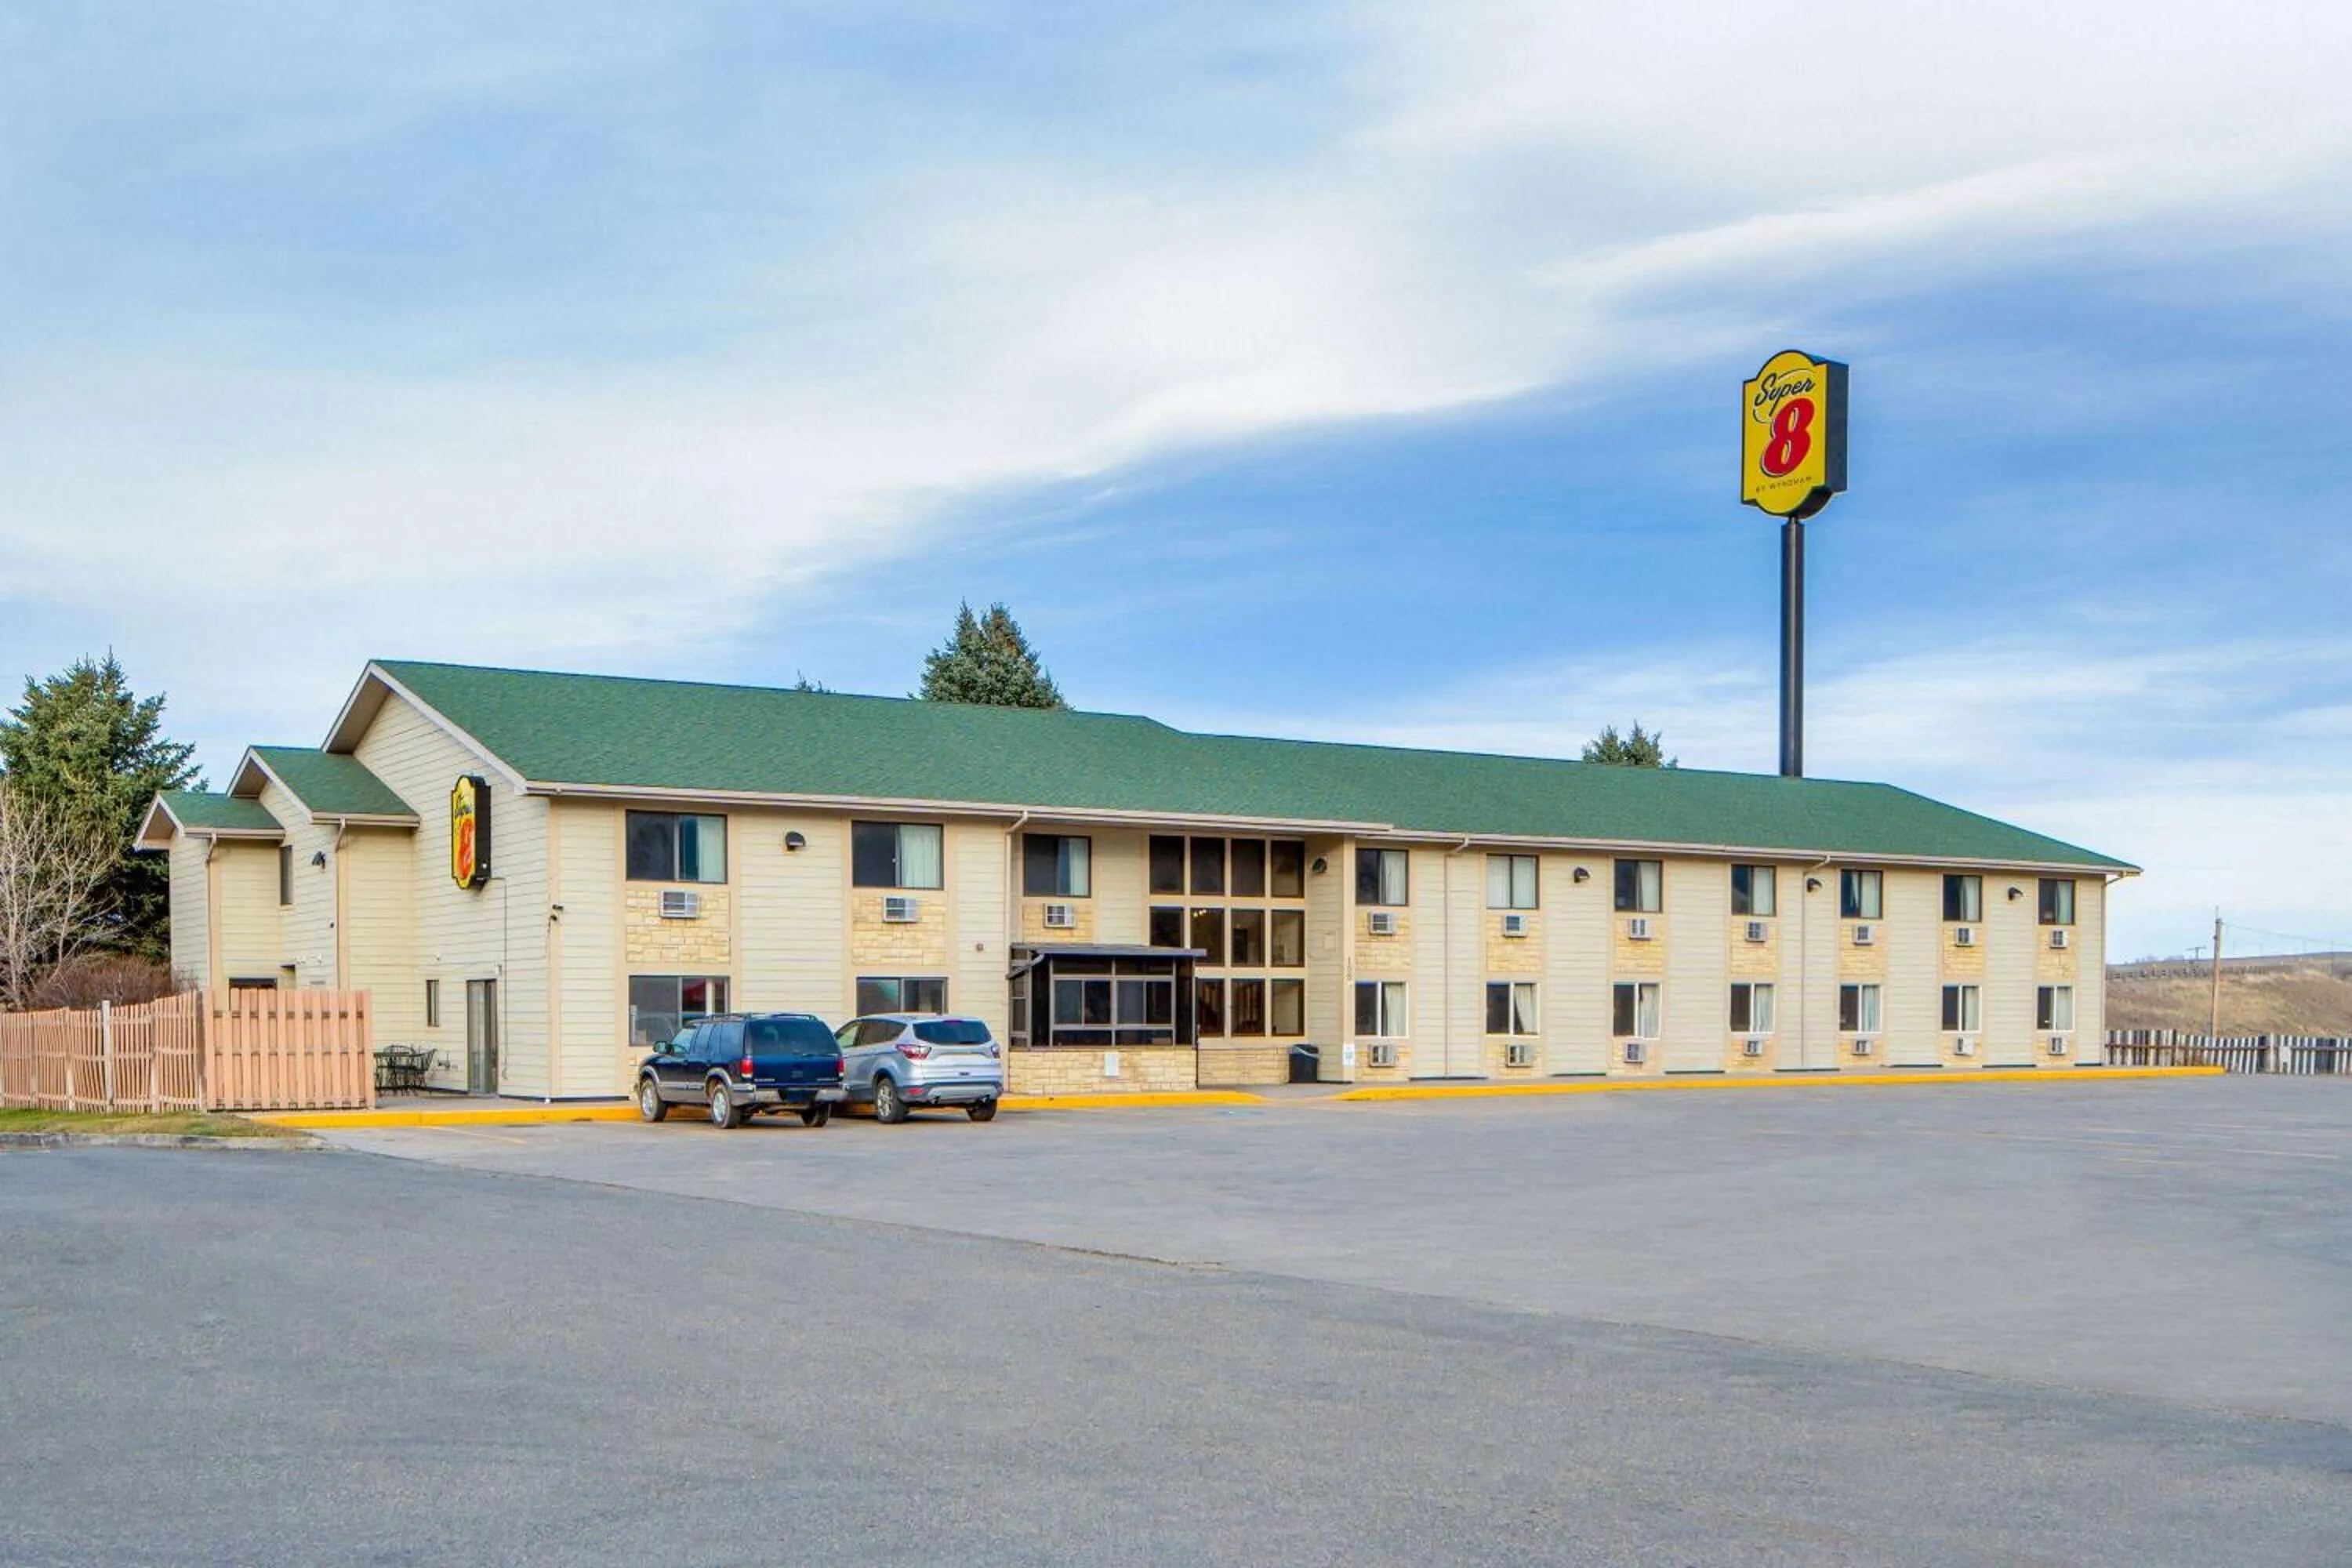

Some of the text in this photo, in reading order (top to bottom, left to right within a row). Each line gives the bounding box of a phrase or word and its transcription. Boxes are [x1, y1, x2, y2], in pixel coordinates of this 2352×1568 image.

[1754, 372, 1816, 416] Super
[1760, 397, 1815, 477] 8
[1755, 485, 1766, 494] BY
